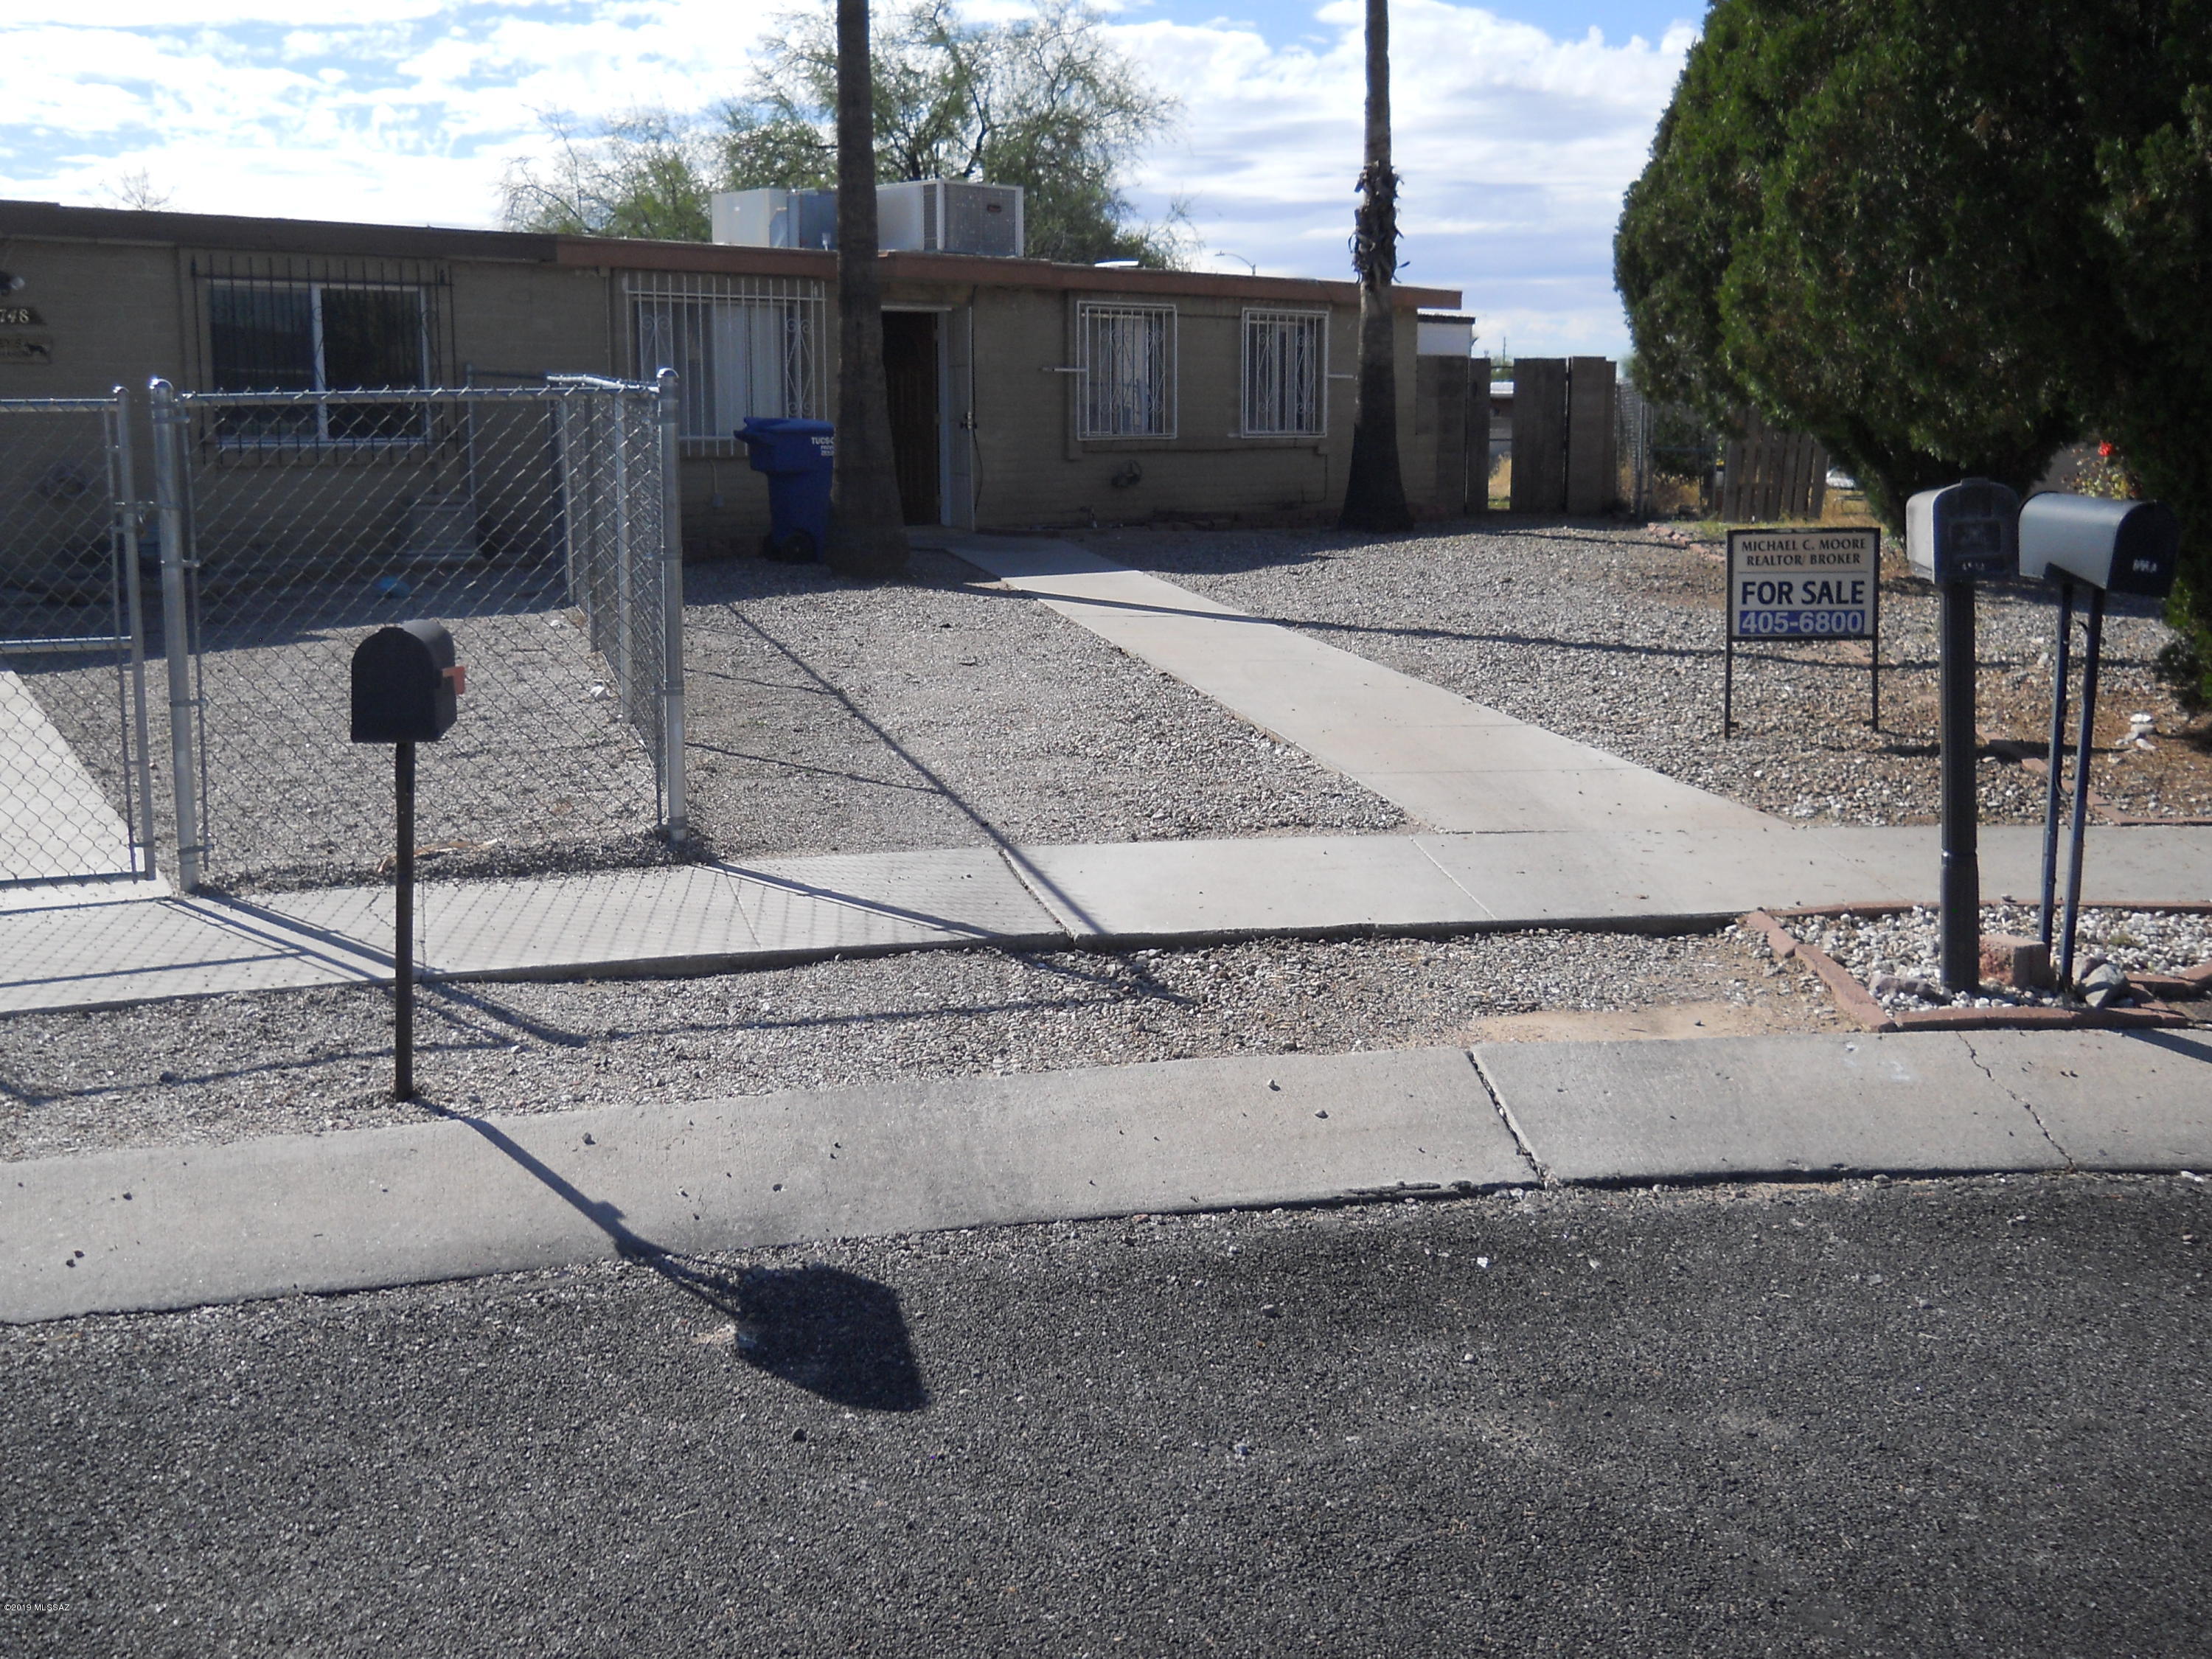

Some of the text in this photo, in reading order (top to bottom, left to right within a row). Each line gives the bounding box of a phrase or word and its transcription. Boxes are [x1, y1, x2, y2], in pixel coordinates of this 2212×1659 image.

[1742, 538, 1866, 552] MICHAEL C. MOORE
[1810, 553, 1860, 565] BROKER
[1742, 580, 1865, 605] FOR SALE
[1742, 611, 1863, 633] 405-6800
